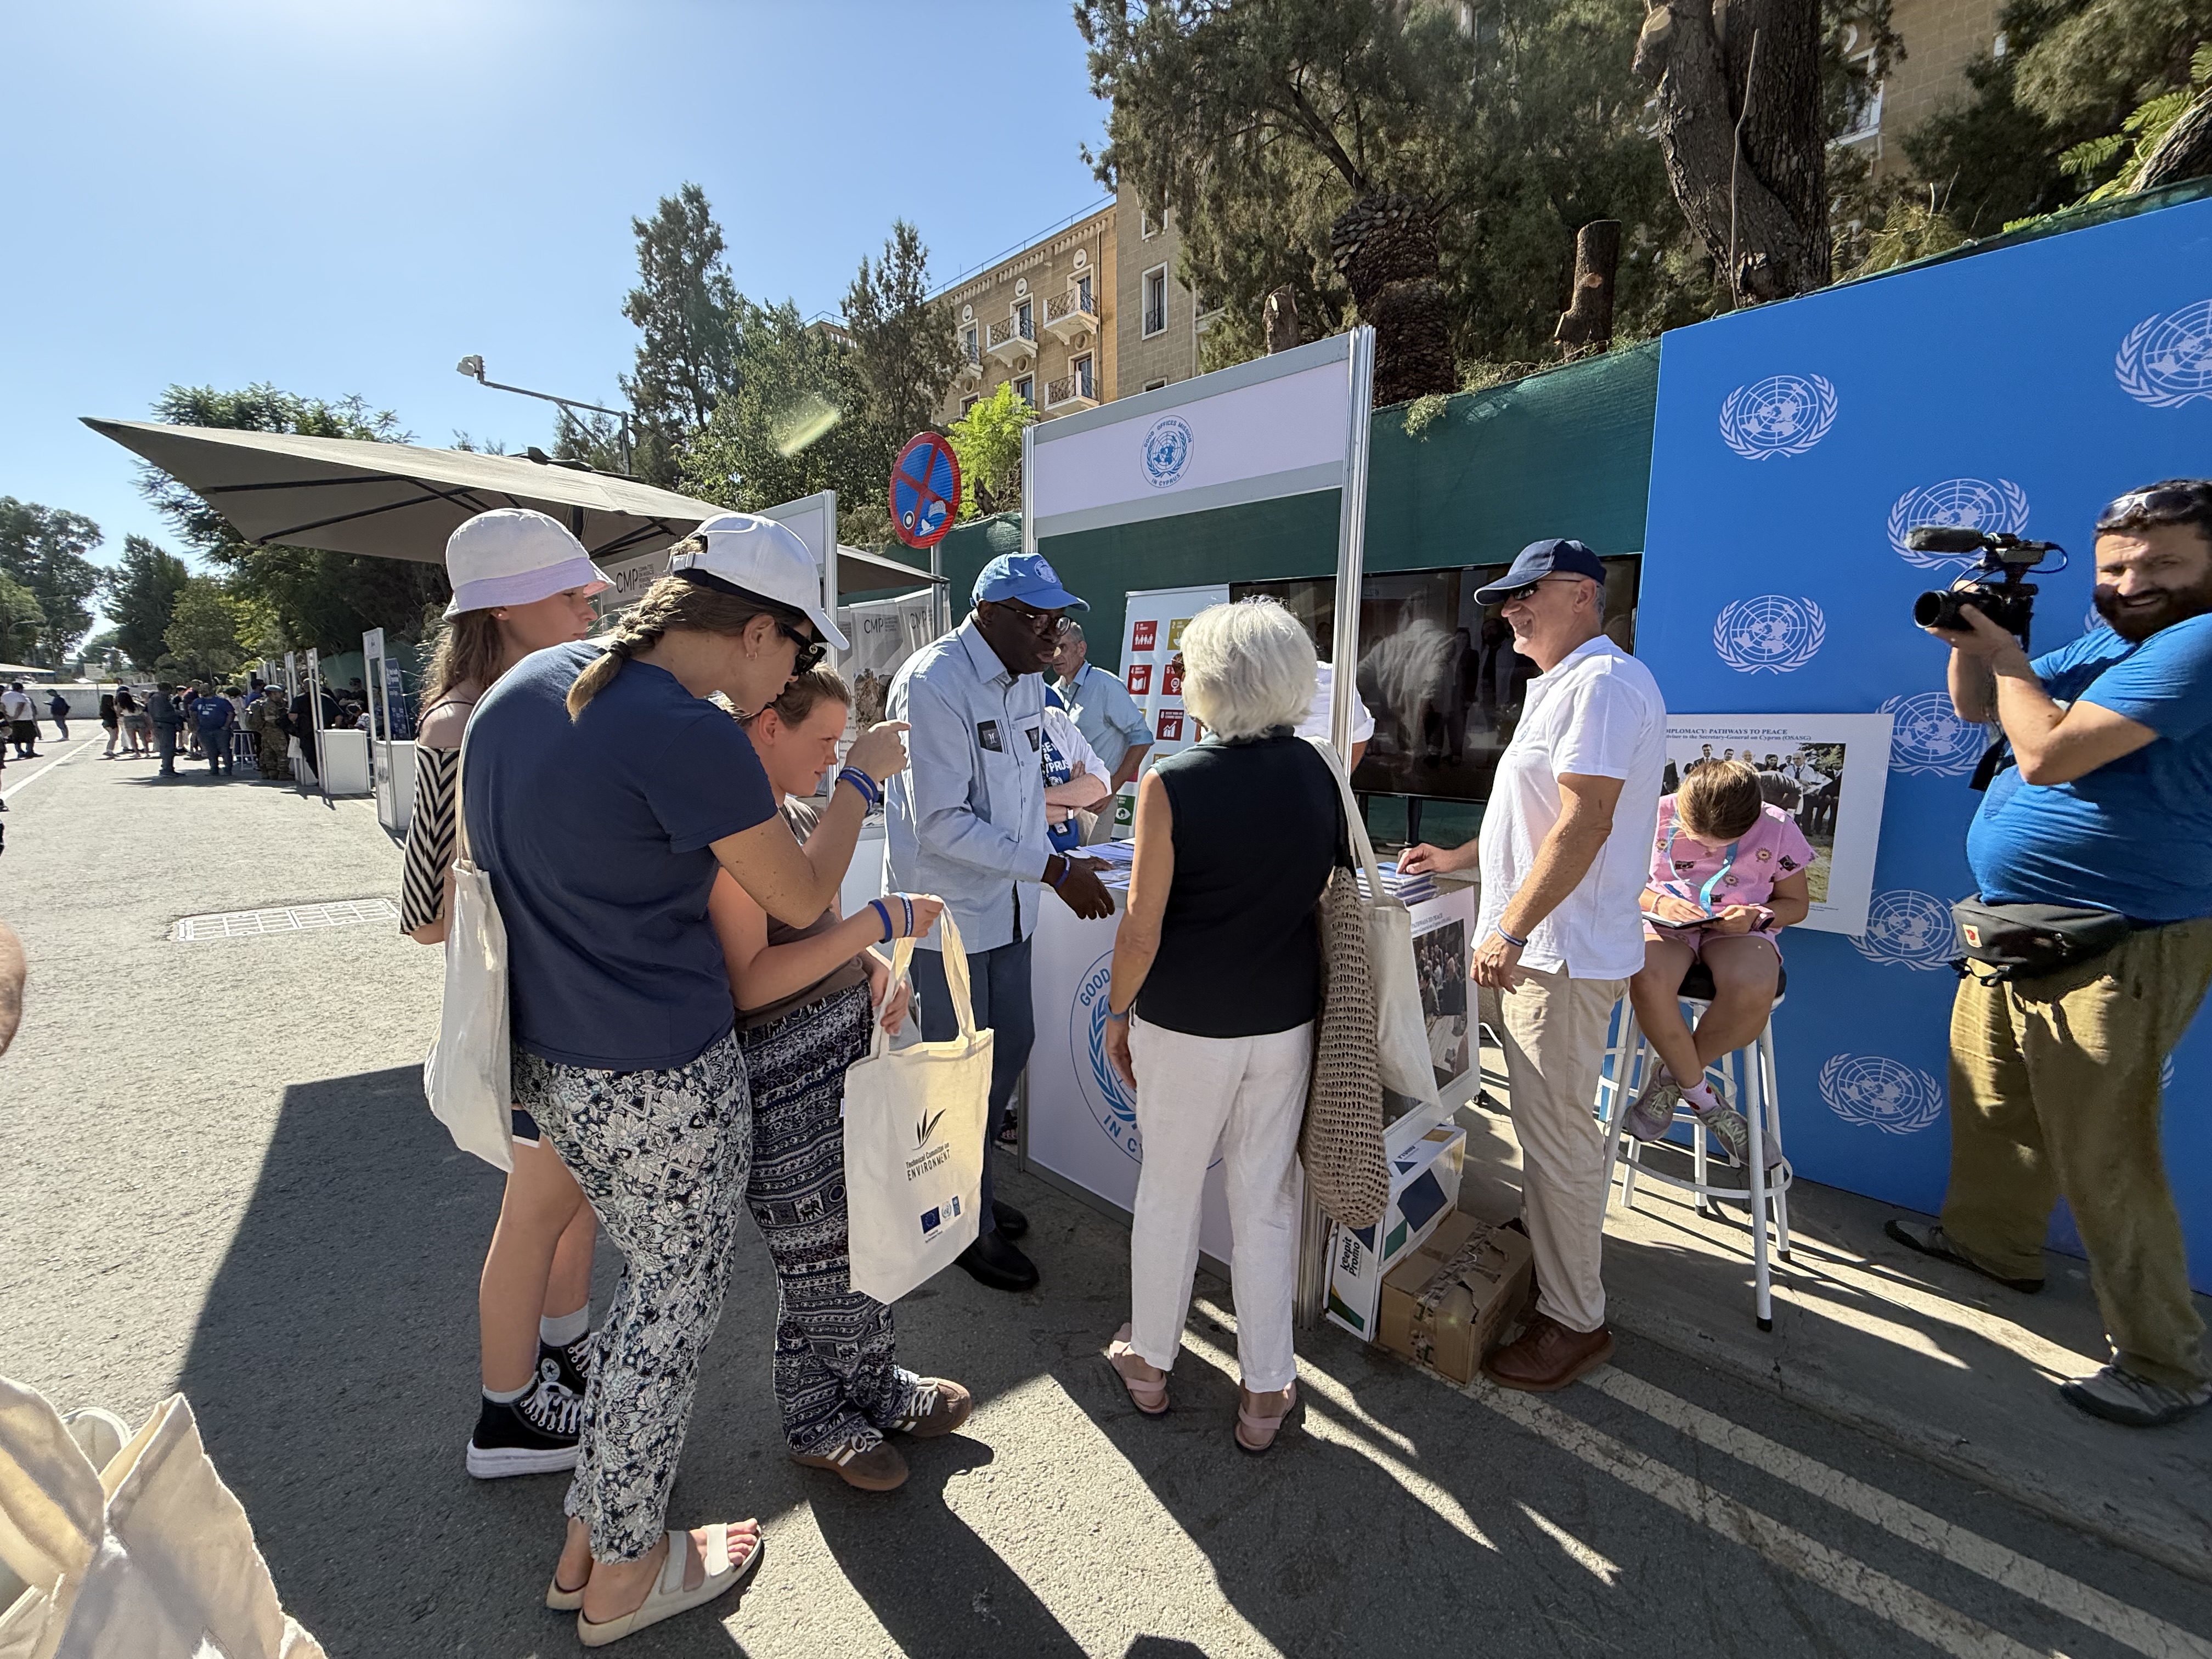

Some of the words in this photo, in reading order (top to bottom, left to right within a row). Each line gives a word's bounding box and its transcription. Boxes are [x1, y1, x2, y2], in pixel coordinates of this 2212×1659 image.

[1144, 431, 1155, 448] GOOD
[1157, 420, 1177, 431] OFFICES
[1177, 422, 1192, 443] MISSION
[1159, 473, 1181, 487] CYPRUS
[616, 567, 638, 593] CMP
[864, 617, 884, 634] CMP
[909, 610, 927, 629] CMP
[1171, 621, 1176, 629] 2
[1166, 666, 1170, 674] 5
[1080, 967, 1111, 1006] GOOD
[1103, 1115, 1121, 1138] IN
[907, 1149, 950, 1181] ENVIRONMENT
[1348, 1242, 1361, 1277] Promo
